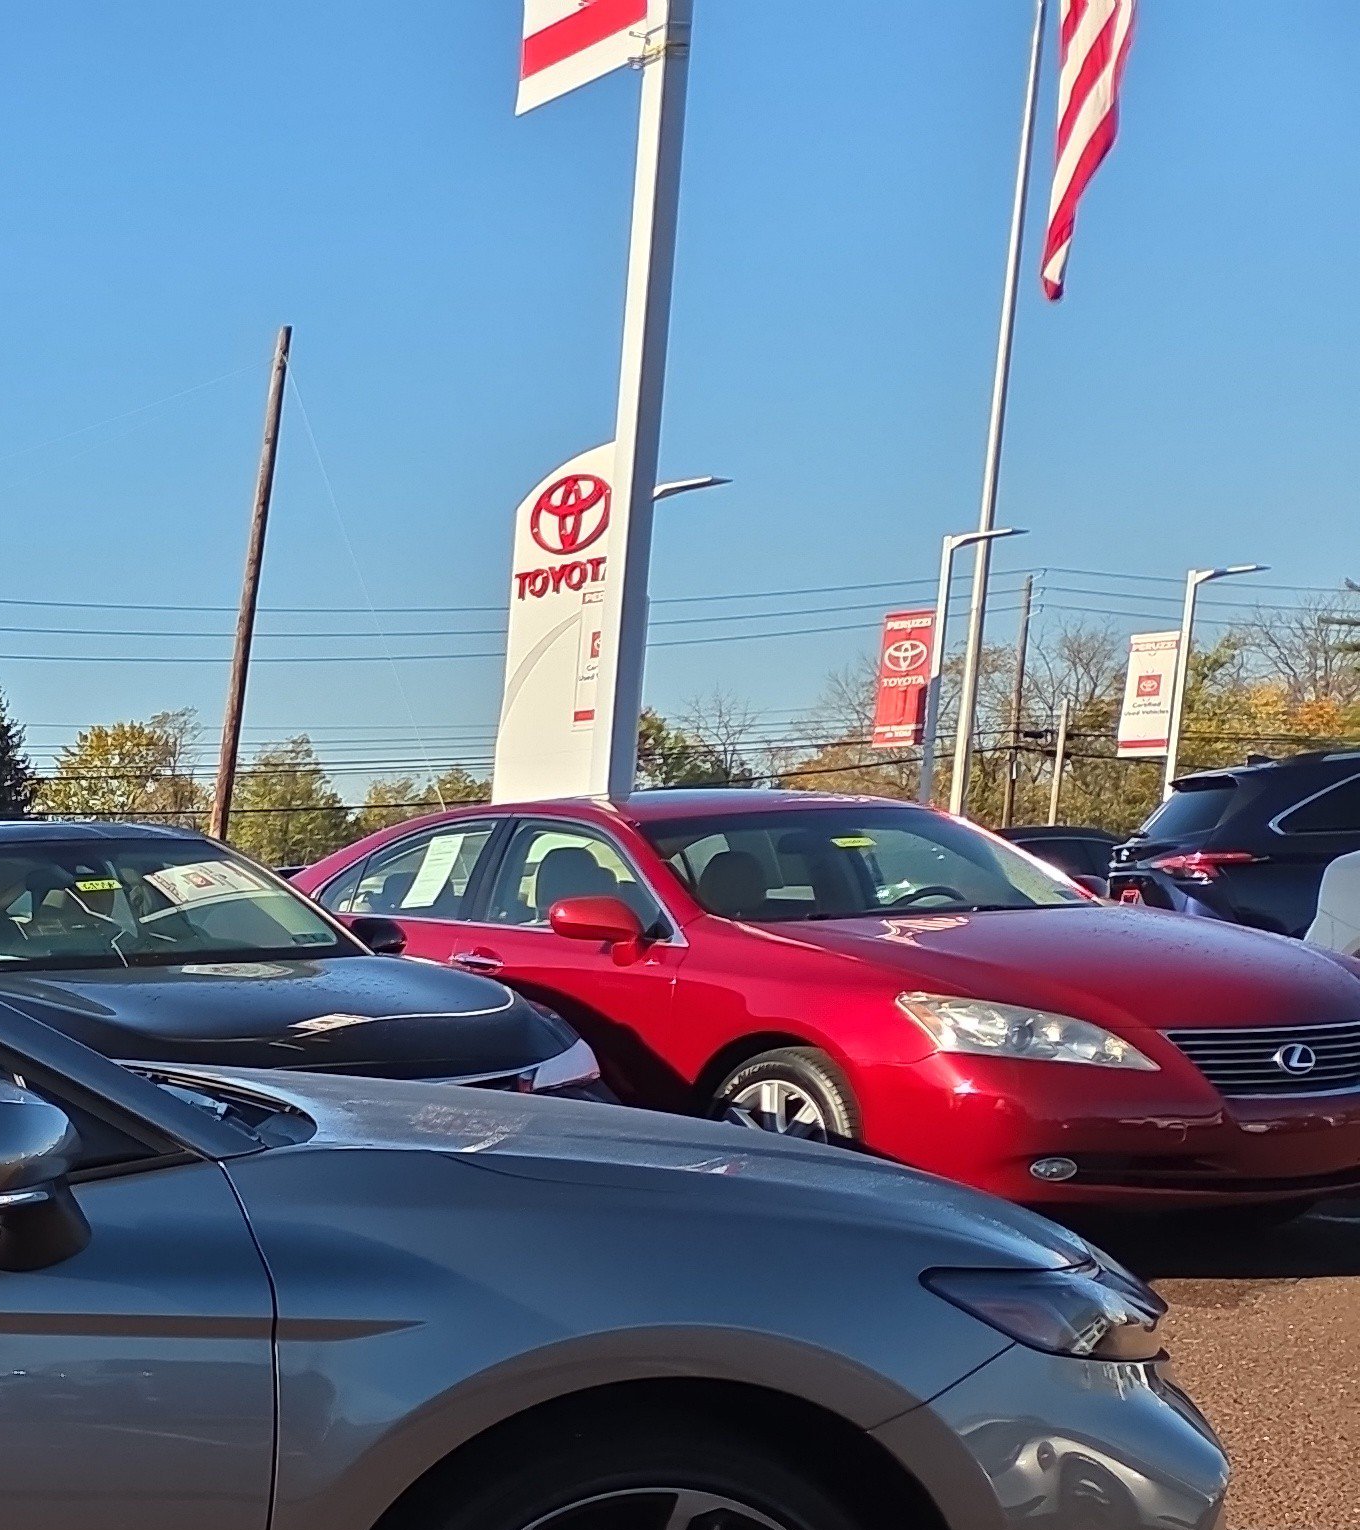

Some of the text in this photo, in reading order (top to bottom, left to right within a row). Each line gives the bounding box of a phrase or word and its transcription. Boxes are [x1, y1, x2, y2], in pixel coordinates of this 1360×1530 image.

[514, 556, 607, 601] TOYOT
[886, 617, 932, 630] PERUZZI
[882, 675, 925, 687] TOYOTA
